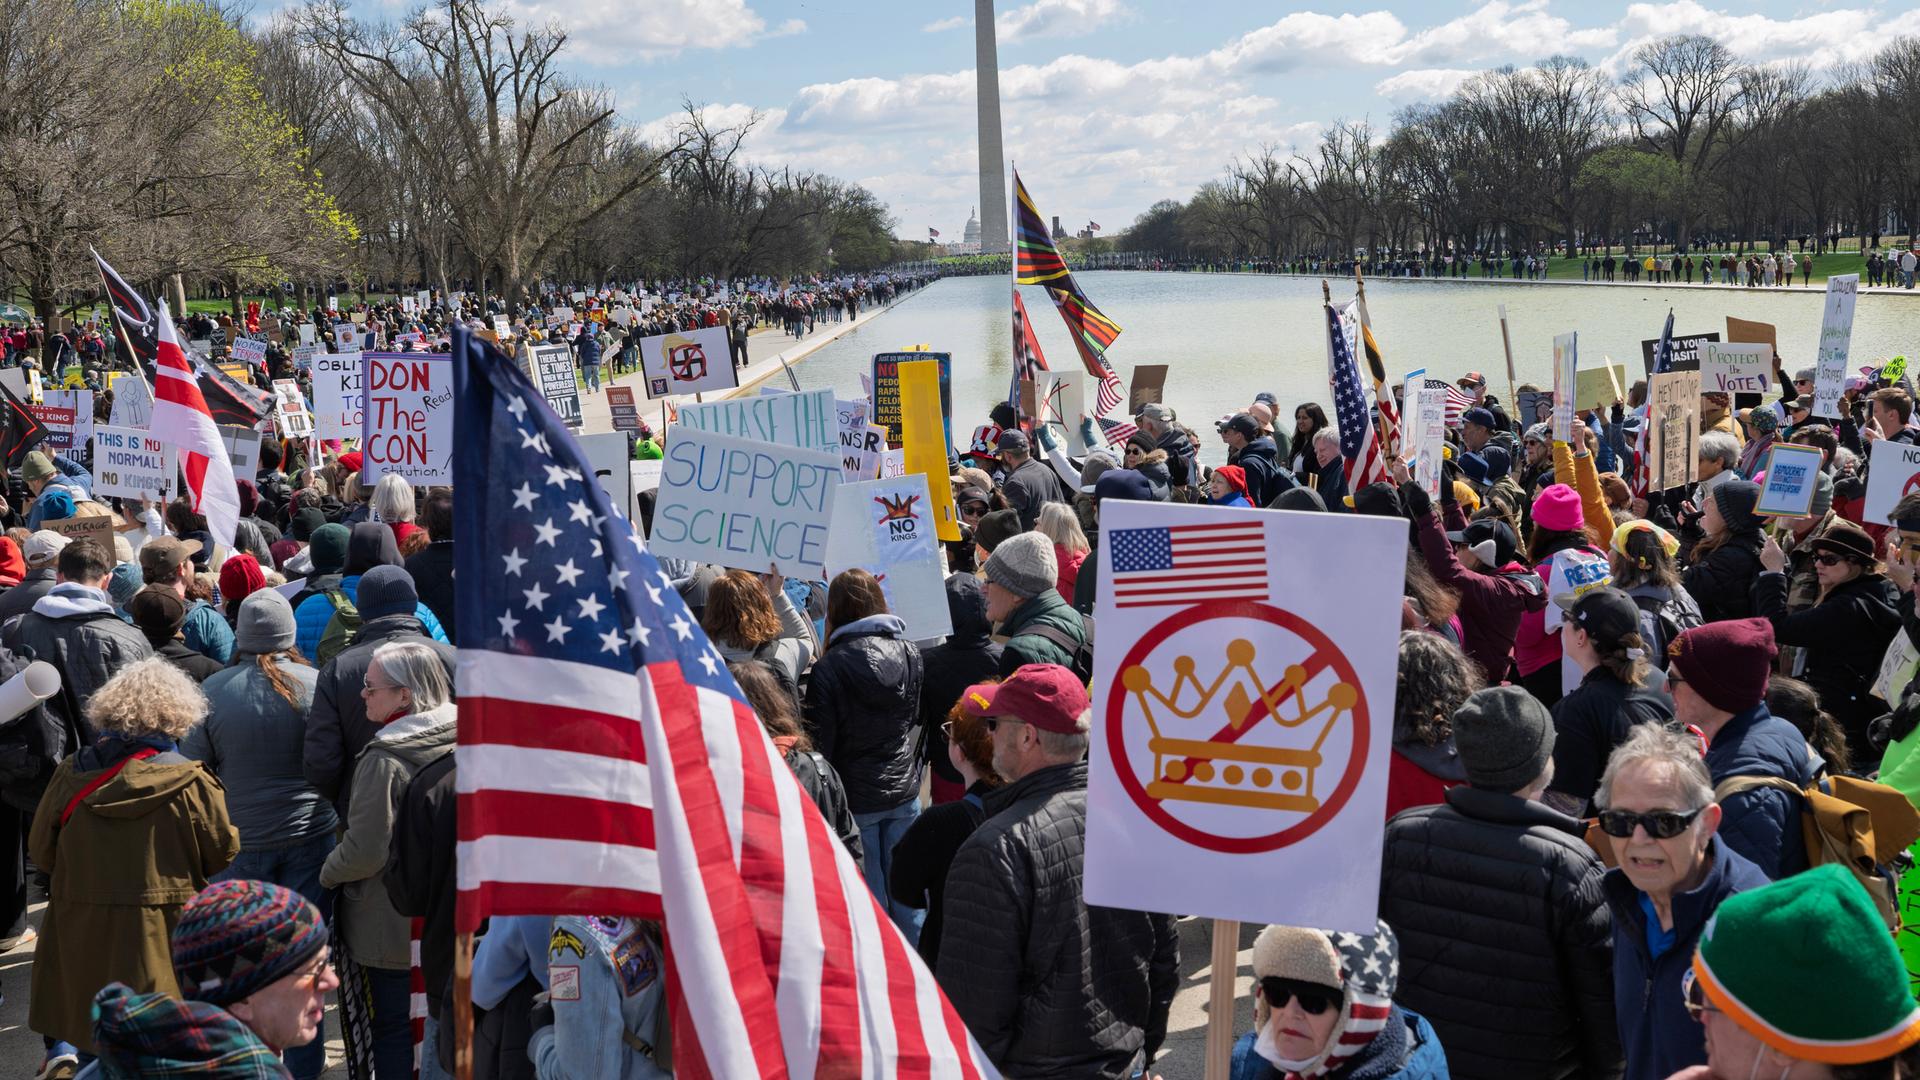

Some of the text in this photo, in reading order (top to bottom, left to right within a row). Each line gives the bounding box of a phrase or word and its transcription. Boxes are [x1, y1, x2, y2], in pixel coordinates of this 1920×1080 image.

[1652, 340, 1680, 352] KW
[1708, 344, 1760, 363] PROTECT
[539, 351, 569, 364] THERE MAY
[540, 361, 571, 374] BE TIMES
[878, 362, 898, 377] NO
[341, 374, 363, 391] KI
[370, 360, 429, 391] DON
[878, 378, 899, 386] PEDO
[544, 379, 575, 391] POWERLESS
[878, 387, 900, 395] RAPIS
[422, 386, 453, 413] Read
[878, 396, 900, 405] FELO
[46, 413, 70, 421] KING
[372, 397, 426, 432] The
[787, 390, 839, 448] THE
[878, 415, 902, 423] RACIS
[97, 432, 123, 448] THIS
[128, 435, 140, 449] IS
[102, 471, 119, 486] NO
[664, 441, 841, 513] SUPPORT
[889, 519, 916, 535] NO
[657, 503, 827, 567] SCIENCE
[890, 532, 918, 542] KINGS
